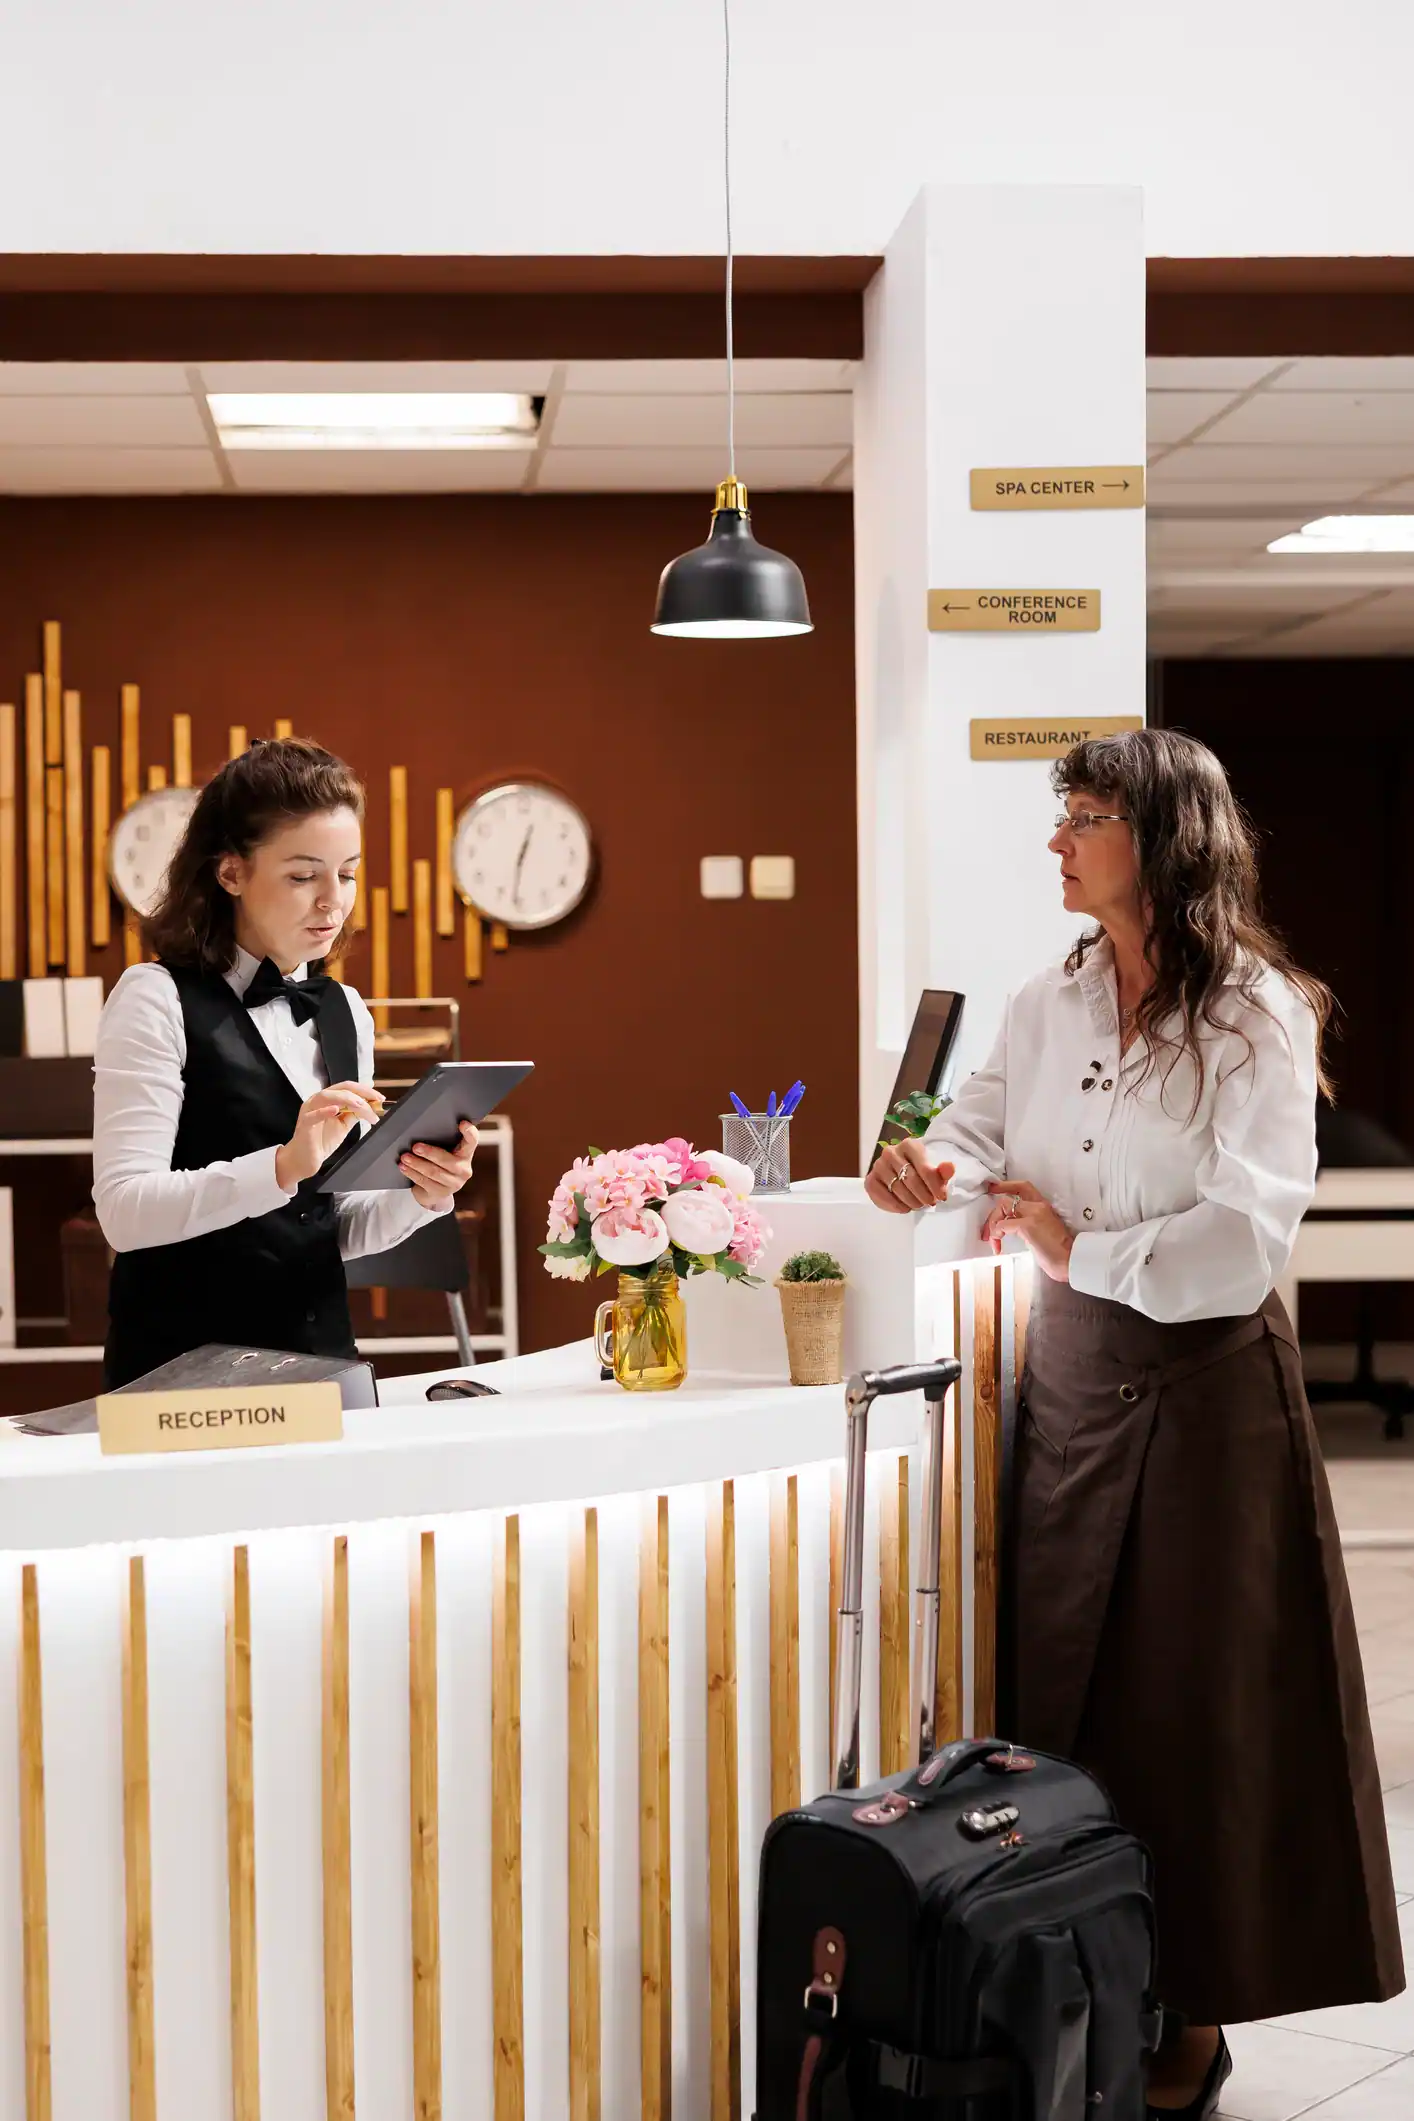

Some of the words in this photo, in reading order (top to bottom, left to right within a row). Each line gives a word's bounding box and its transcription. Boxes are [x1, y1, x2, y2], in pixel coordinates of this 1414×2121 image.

[995, 481, 1026, 495] SPA
[1030, 481, 1095, 494] CENTER
[977, 595, 1087, 609] CONFERENCE
[1008, 610, 1057, 623] ROOM
[984, 731, 1091, 745] RESTAURANT
[158, 1406, 286, 1431] RECEPTION
